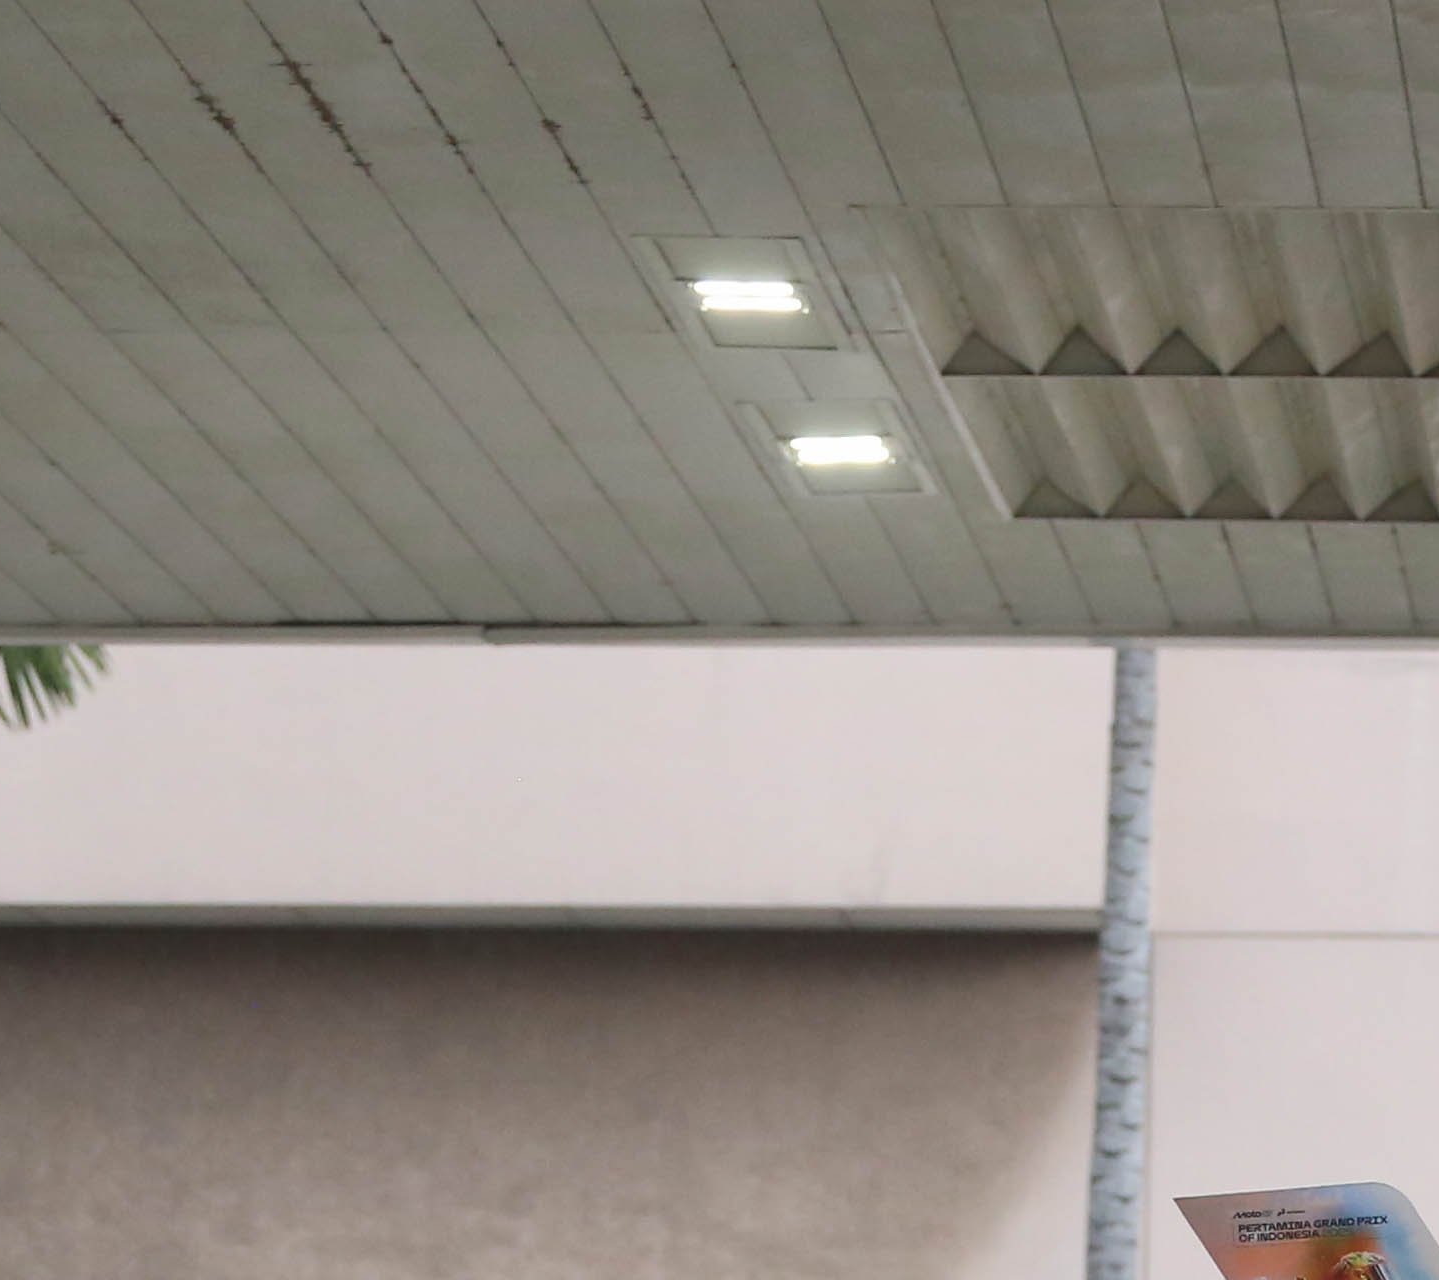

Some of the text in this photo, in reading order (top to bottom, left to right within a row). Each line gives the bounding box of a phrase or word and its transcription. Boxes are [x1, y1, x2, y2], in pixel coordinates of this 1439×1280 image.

[1238, 1215, 1388, 1233] PERTAMINA GRAND PRIX
[1239, 1233, 1255, 1243] OF
[1257, 1230, 1320, 1242] INDONESIA
